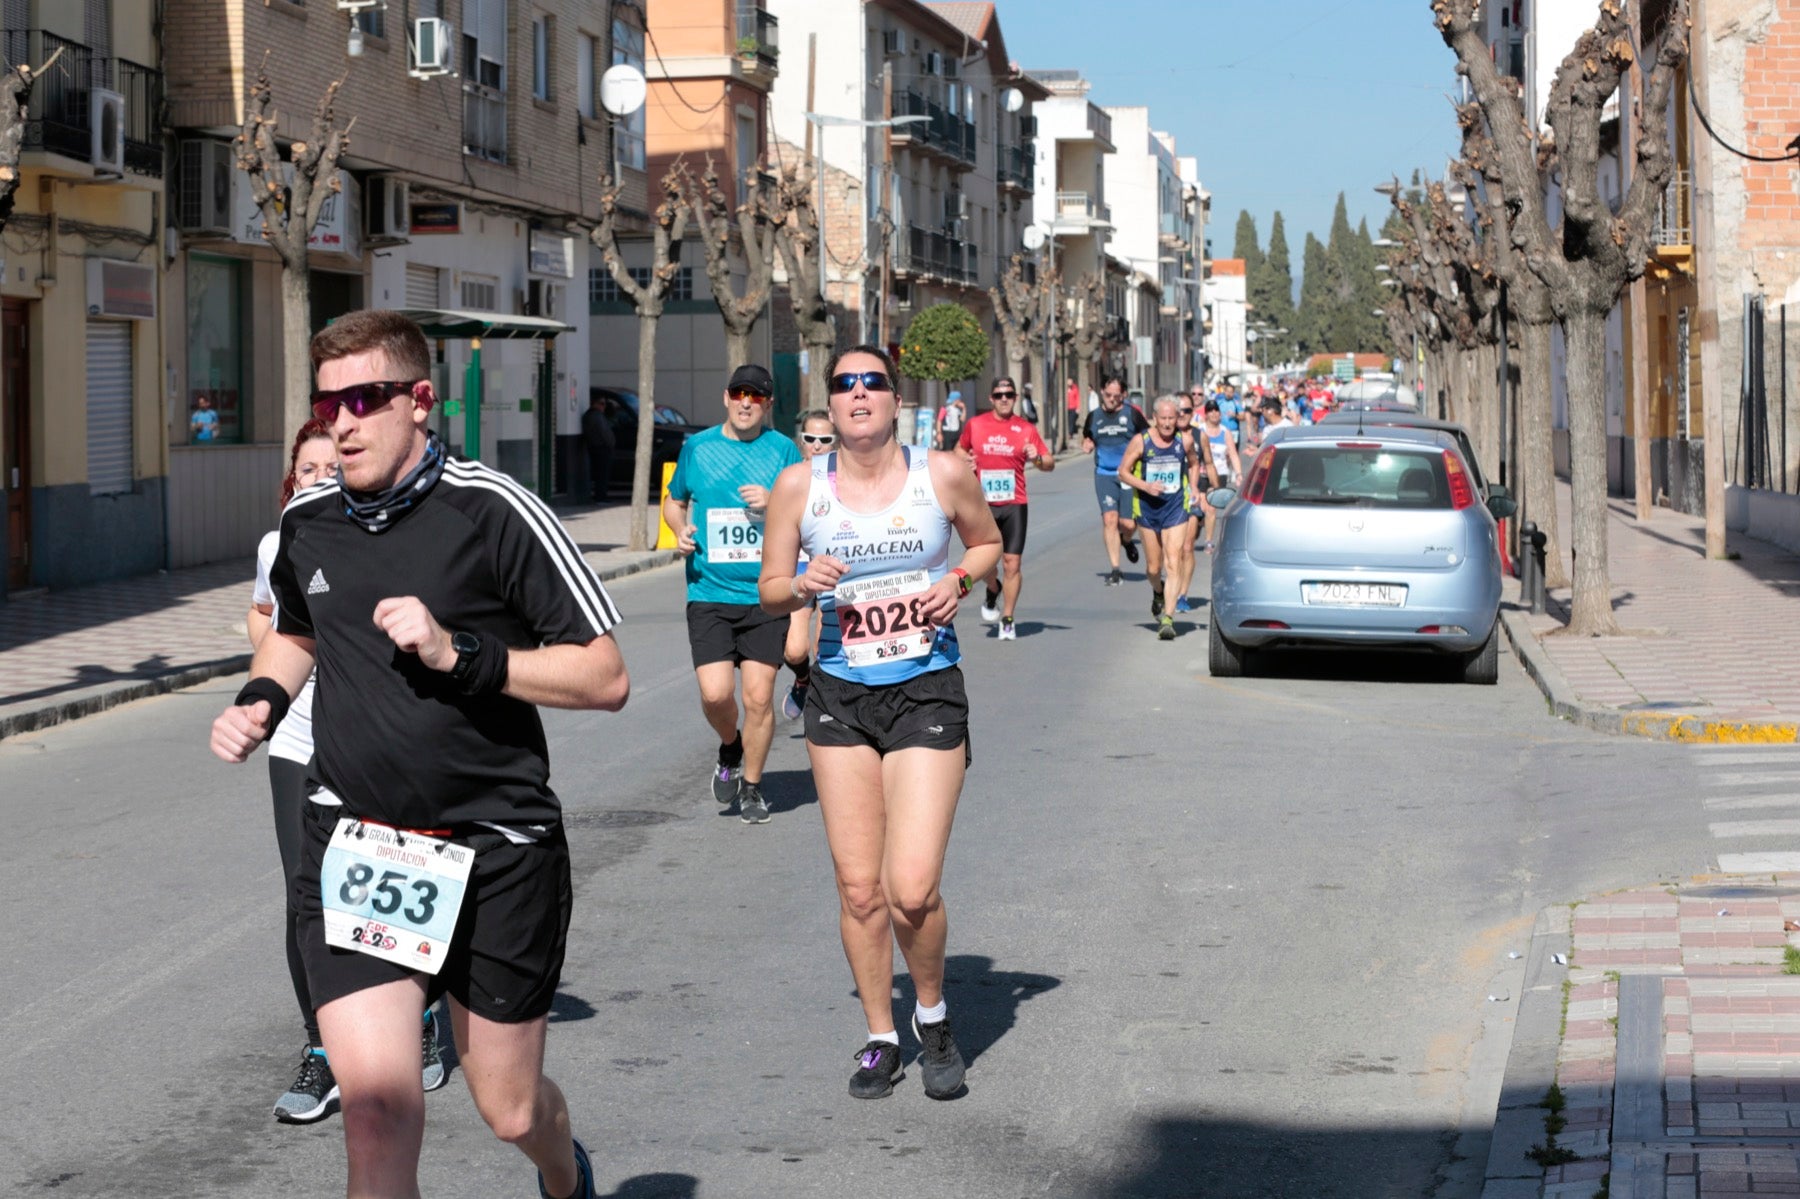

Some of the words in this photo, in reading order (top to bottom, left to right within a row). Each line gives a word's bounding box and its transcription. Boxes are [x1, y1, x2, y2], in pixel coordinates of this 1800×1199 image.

[988, 434, 1007, 445] edp
[986, 480, 1010, 491] 135
[1153, 472, 1174, 483] 769
[718, 525, 758, 545] 196
[856, 582, 871, 593] GRAN
[872, 578, 894, 589] PREMIO
[895, 576, 902, 585] DE
[904, 573, 923, 584] FONDO
[1322, 584, 1361, 599] 7023
[1368, 585, 1396, 601] FNL
[843, 598, 930, 640] 2028
[368, 828, 392, 845] GRAN
[339, 862, 438, 925] 853
